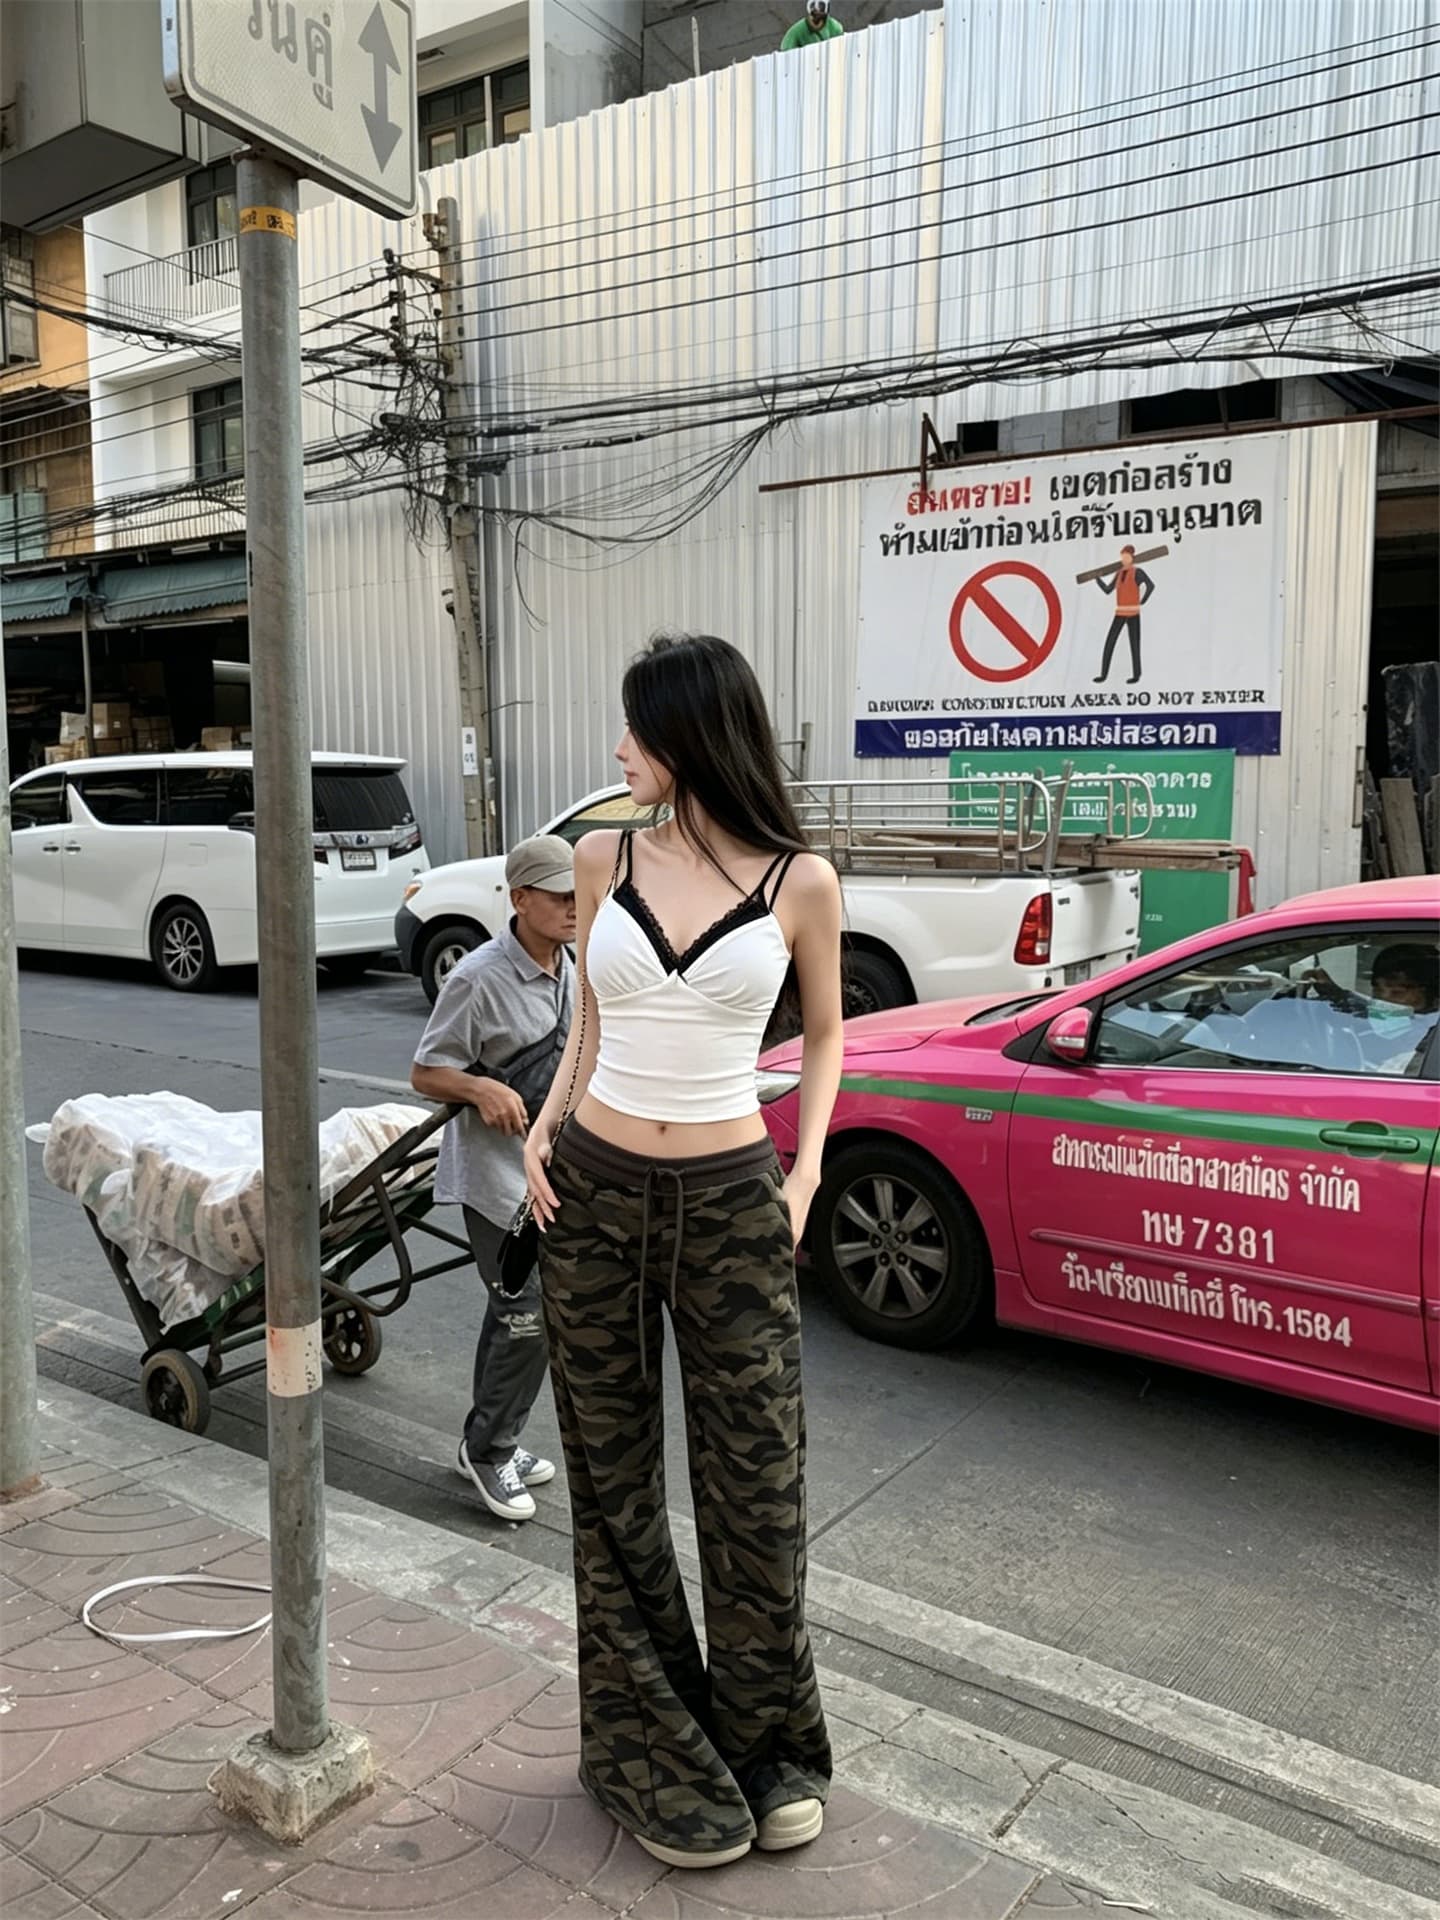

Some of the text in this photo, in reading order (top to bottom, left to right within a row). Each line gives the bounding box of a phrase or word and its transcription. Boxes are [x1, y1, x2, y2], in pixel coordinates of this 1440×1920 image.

[1049, 451, 1232, 501] เขตก่อสร้าง
[1299, 1163, 1361, 1212] จำกัด
[1191, 1217, 1275, 1264] 7381
